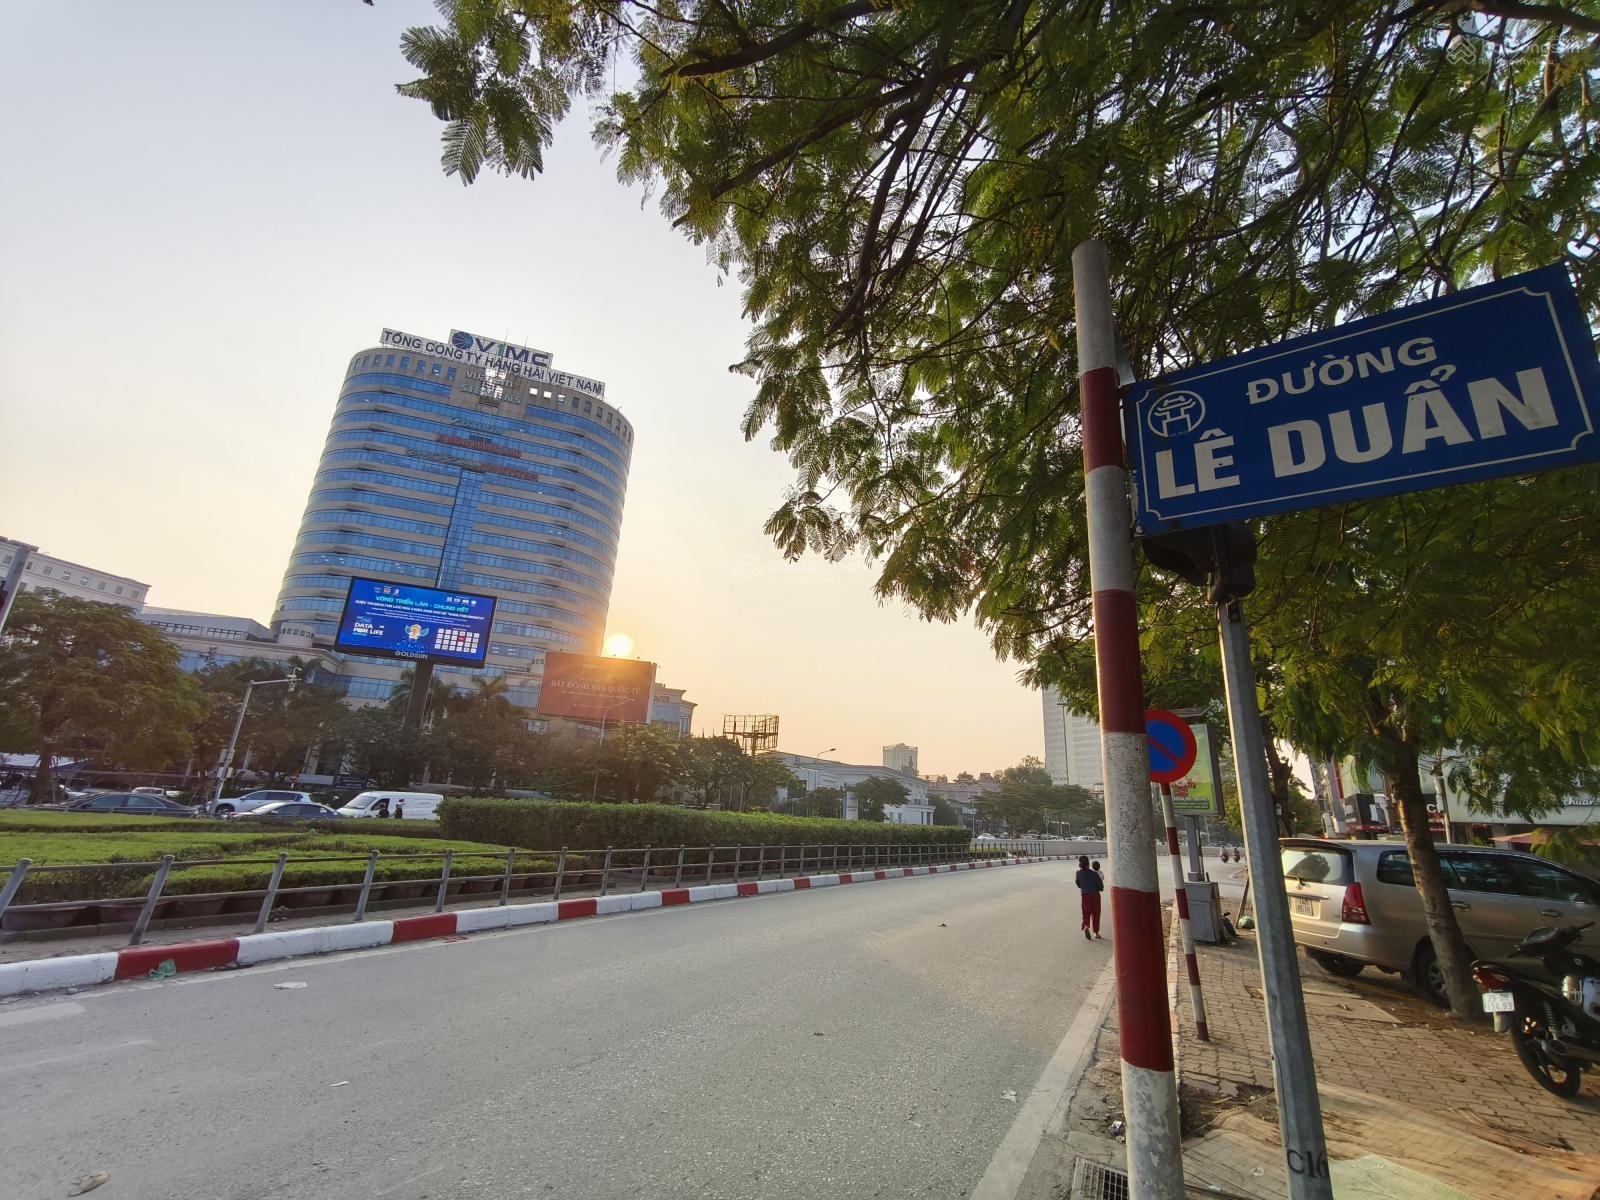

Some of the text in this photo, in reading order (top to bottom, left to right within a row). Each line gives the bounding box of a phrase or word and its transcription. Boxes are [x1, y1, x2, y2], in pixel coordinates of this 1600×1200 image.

[384, 331, 422, 349] TỔNG
[425, 341, 463, 360] CÔNG
[465, 352, 483, 364] TY
[485, 355, 521, 373] HÀNG
[548, 370, 574, 387] VIỆT
[576, 379, 603, 395] NAM
[475, 337, 549, 367] VIMC
[1246, 337, 1437, 405] ĐƯỜNG
[1155, 363, 1558, 499] LÊ DUẨN
[395, 650, 429, 660] GOLDSUN
